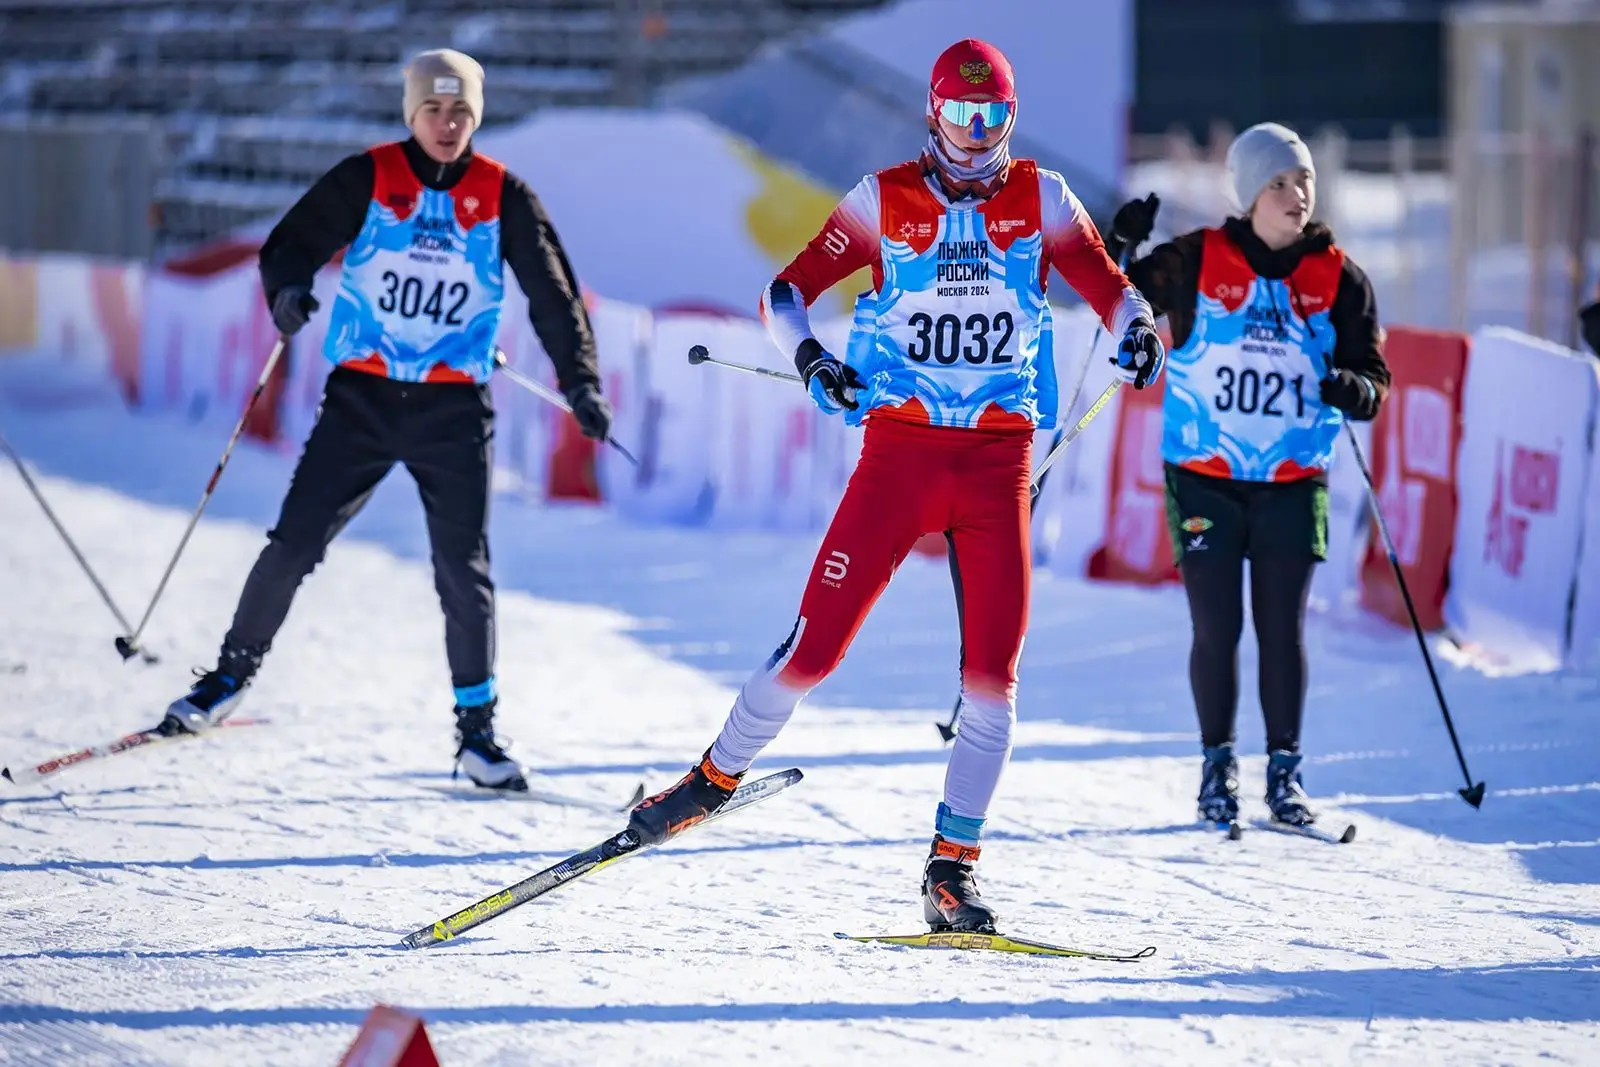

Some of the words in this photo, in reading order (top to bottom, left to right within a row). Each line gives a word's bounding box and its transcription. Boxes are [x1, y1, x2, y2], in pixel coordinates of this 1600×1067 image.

[938, 240, 988, 260] ЛЫЖНЯ
[937, 262, 989, 281] РОССИИ
[378, 269, 470, 326] 3042
[937, 287, 968, 297] МОСКВА
[971, 285, 990, 296] 2024
[908, 311, 1014, 364] 3032
[1214, 366, 1304, 418] 3021
[448, 889, 513, 928] FISCHER
[926, 934, 993, 949] FISCHER
